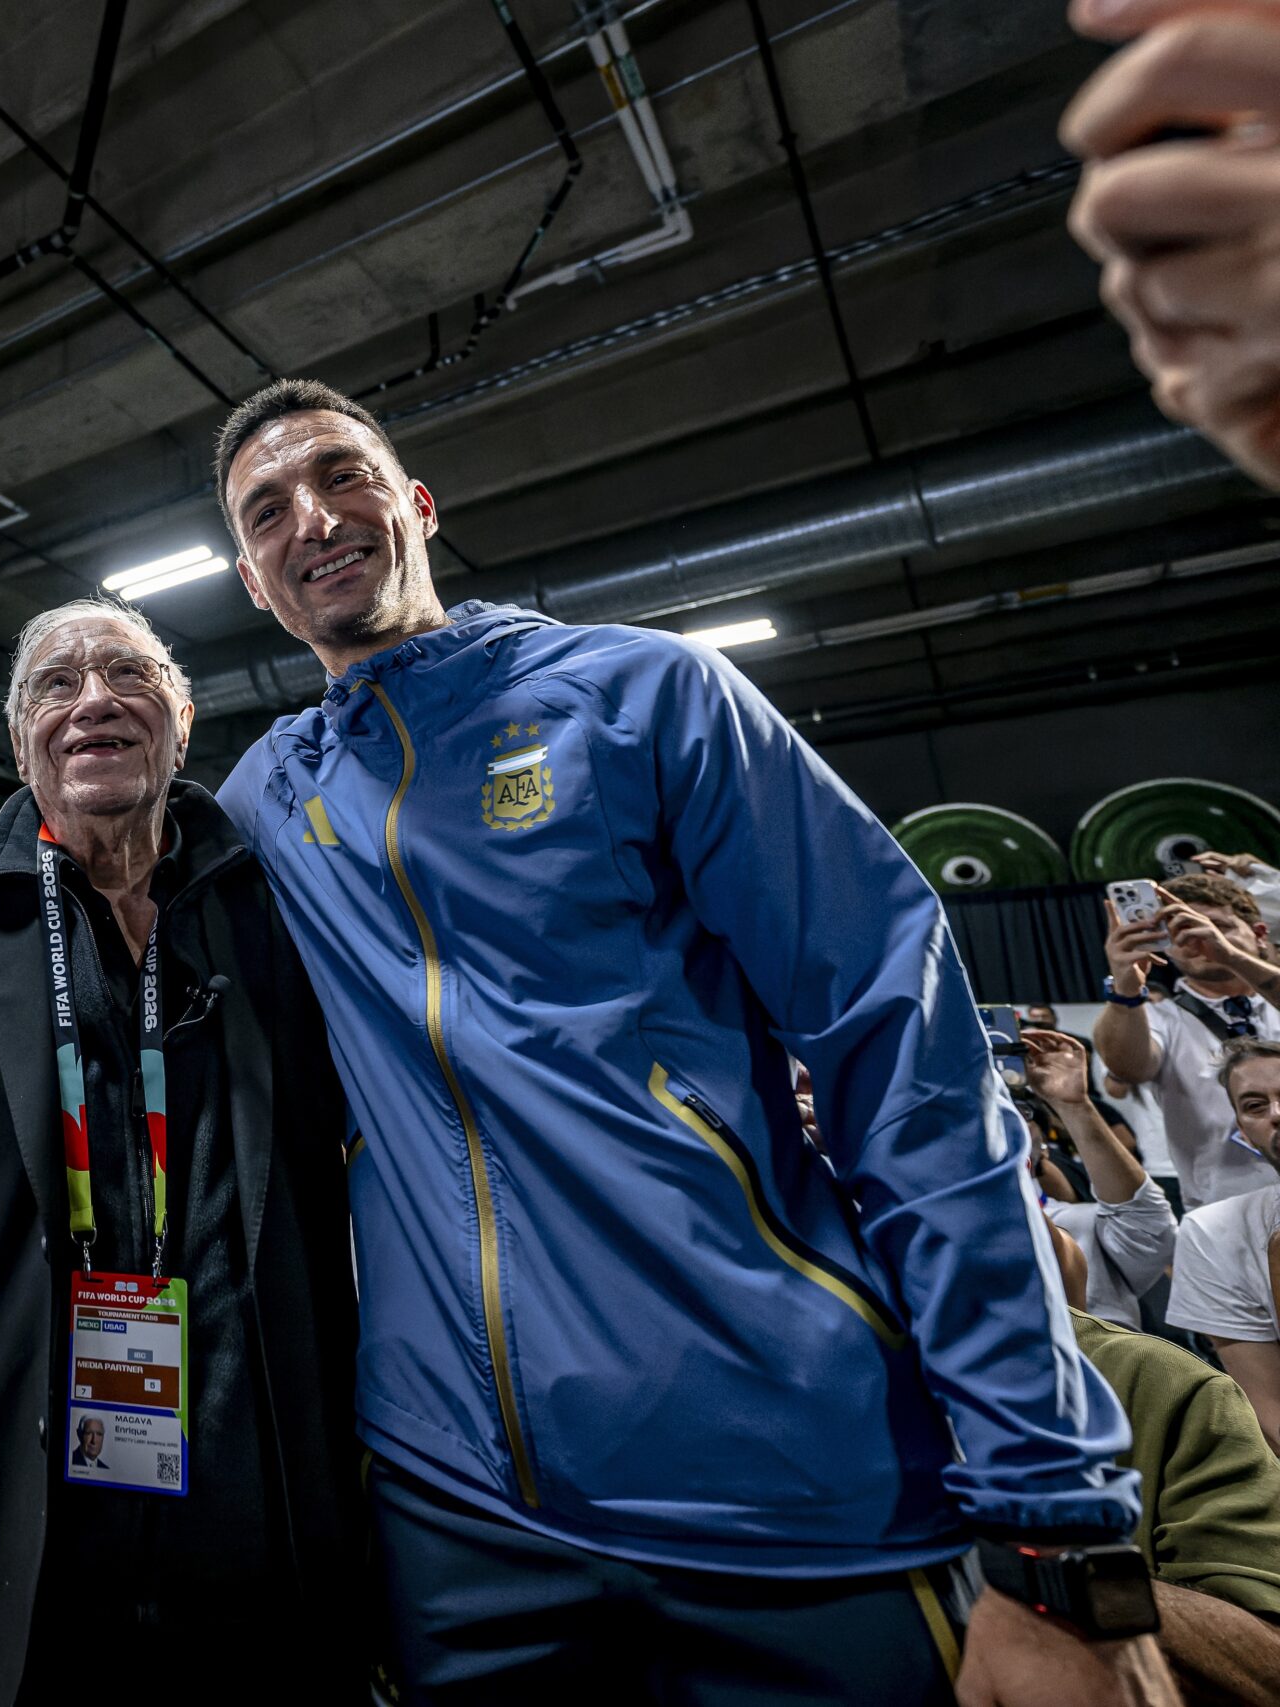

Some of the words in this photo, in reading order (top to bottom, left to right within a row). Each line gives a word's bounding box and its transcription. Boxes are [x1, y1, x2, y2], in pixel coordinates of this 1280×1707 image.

[497, 769, 540, 806] AFA
[41, 850, 57, 898] 2026
[47, 901, 61, 930] CUP
[49, 932, 68, 991] WORLD
[145, 945, 158, 972] CUP
[57, 991, 72, 1027] FIFA
[144, 974, 158, 1030] 2026
[78, 1291, 96, 1300] FIFA
[97, 1293, 127, 1303] WORLD
[128, 1295, 145, 1304] CUP
[146, 1297, 176, 1307] 2026
[98, 1310, 140, 1320] TOURNAMENT
[77, 1360, 103, 1370] MEDIA
[104, 1363, 144, 1374] PARTNER
[115, 1426, 147, 1437] Enrique
